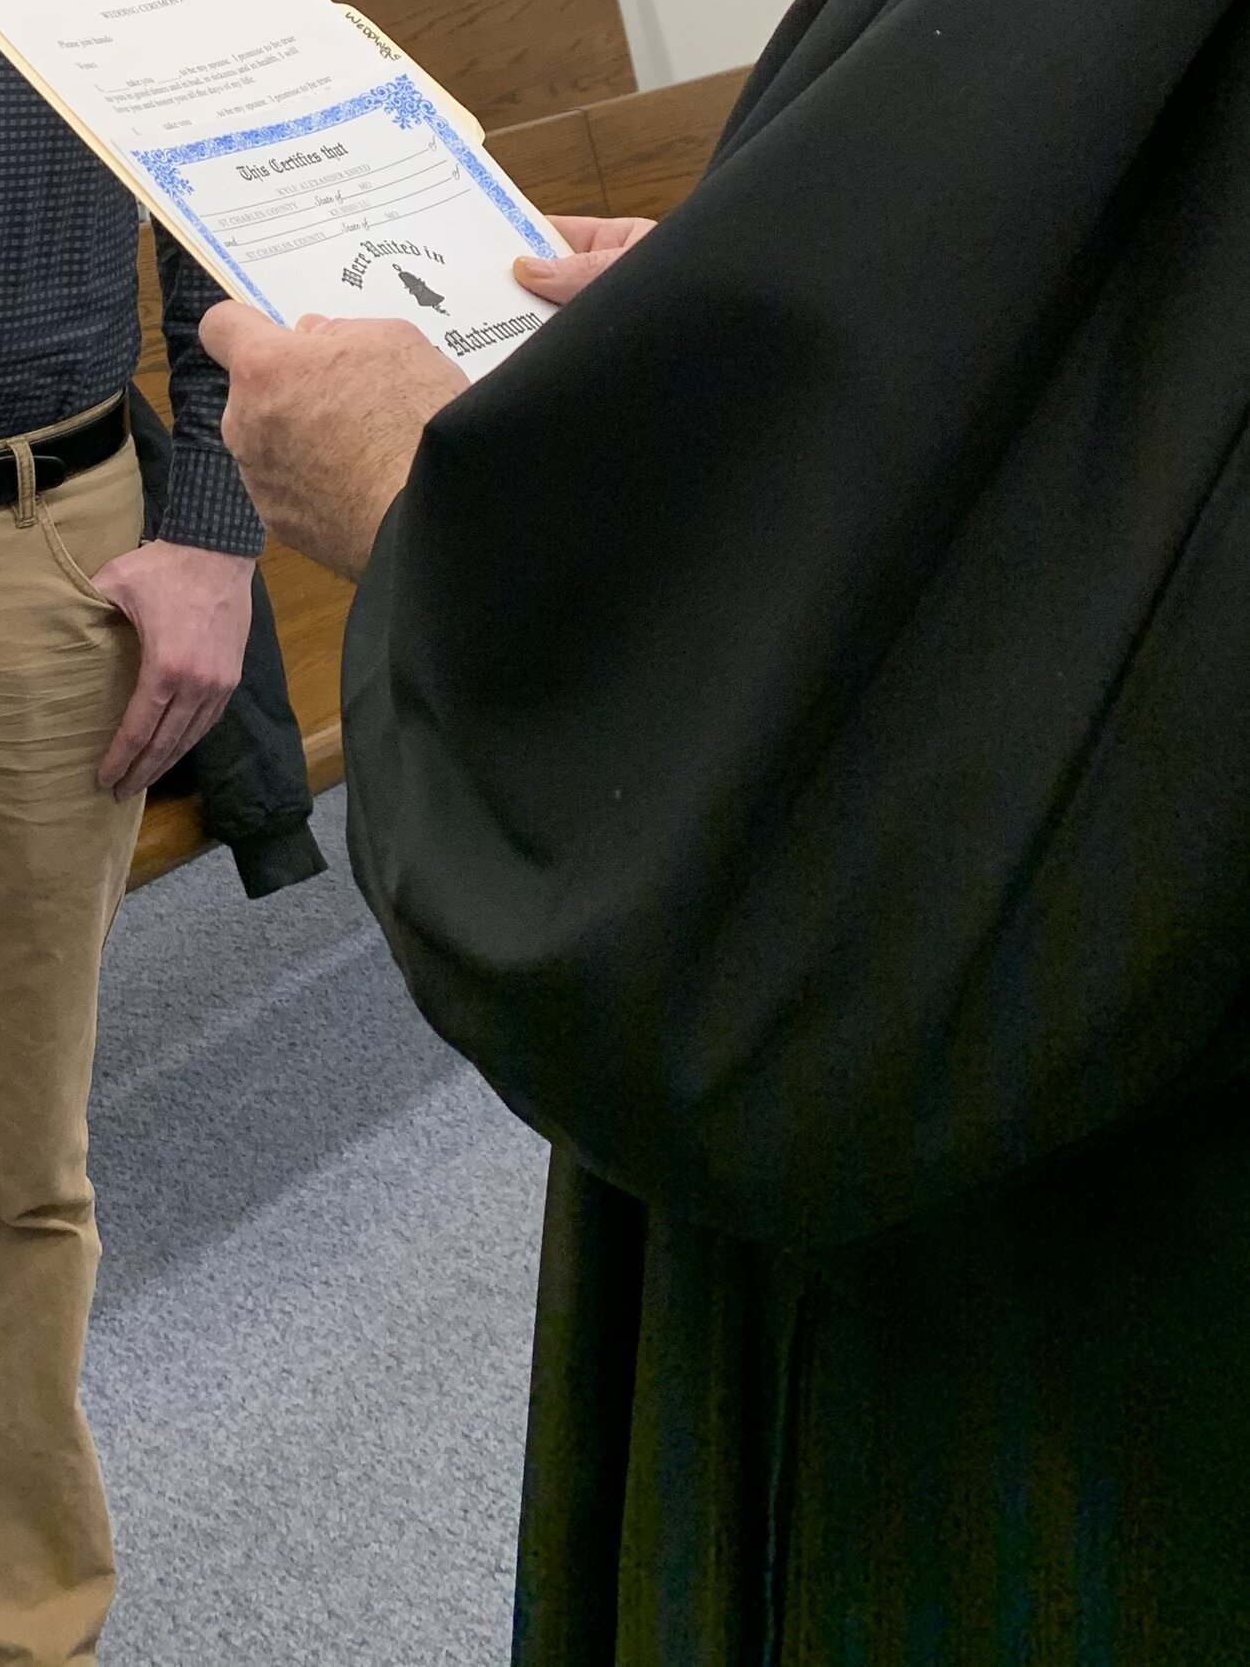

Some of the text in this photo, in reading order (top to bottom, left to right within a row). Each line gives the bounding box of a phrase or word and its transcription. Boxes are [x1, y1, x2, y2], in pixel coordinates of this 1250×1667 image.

[100, 6, 140, 20] WEDDING
[238, 48, 264, 62] promise
[280, 36, 296, 46] true
[284, 46, 300, 56] will
[274, 89, 300, 102] promise
[316, 76, 332, 86] true
[236, 142, 349, 182] This Certifies that
[300, 171, 344, 191] ALEXANDER
[428, 134, 438, 152] of
[224, 236, 238, 247] and
[452, 163, 460, 180] of
[266, 202, 299, 217] COUNTY
[315, 194, 334, 207] State
[334, 190, 344, 204] of
[358, 182, 372, 190] MO
[293, 231, 327, 248] COUNTY
[342, 222, 361, 234] State
[362, 217, 371, 231] of
[341, 239, 446, 290] Were United in
